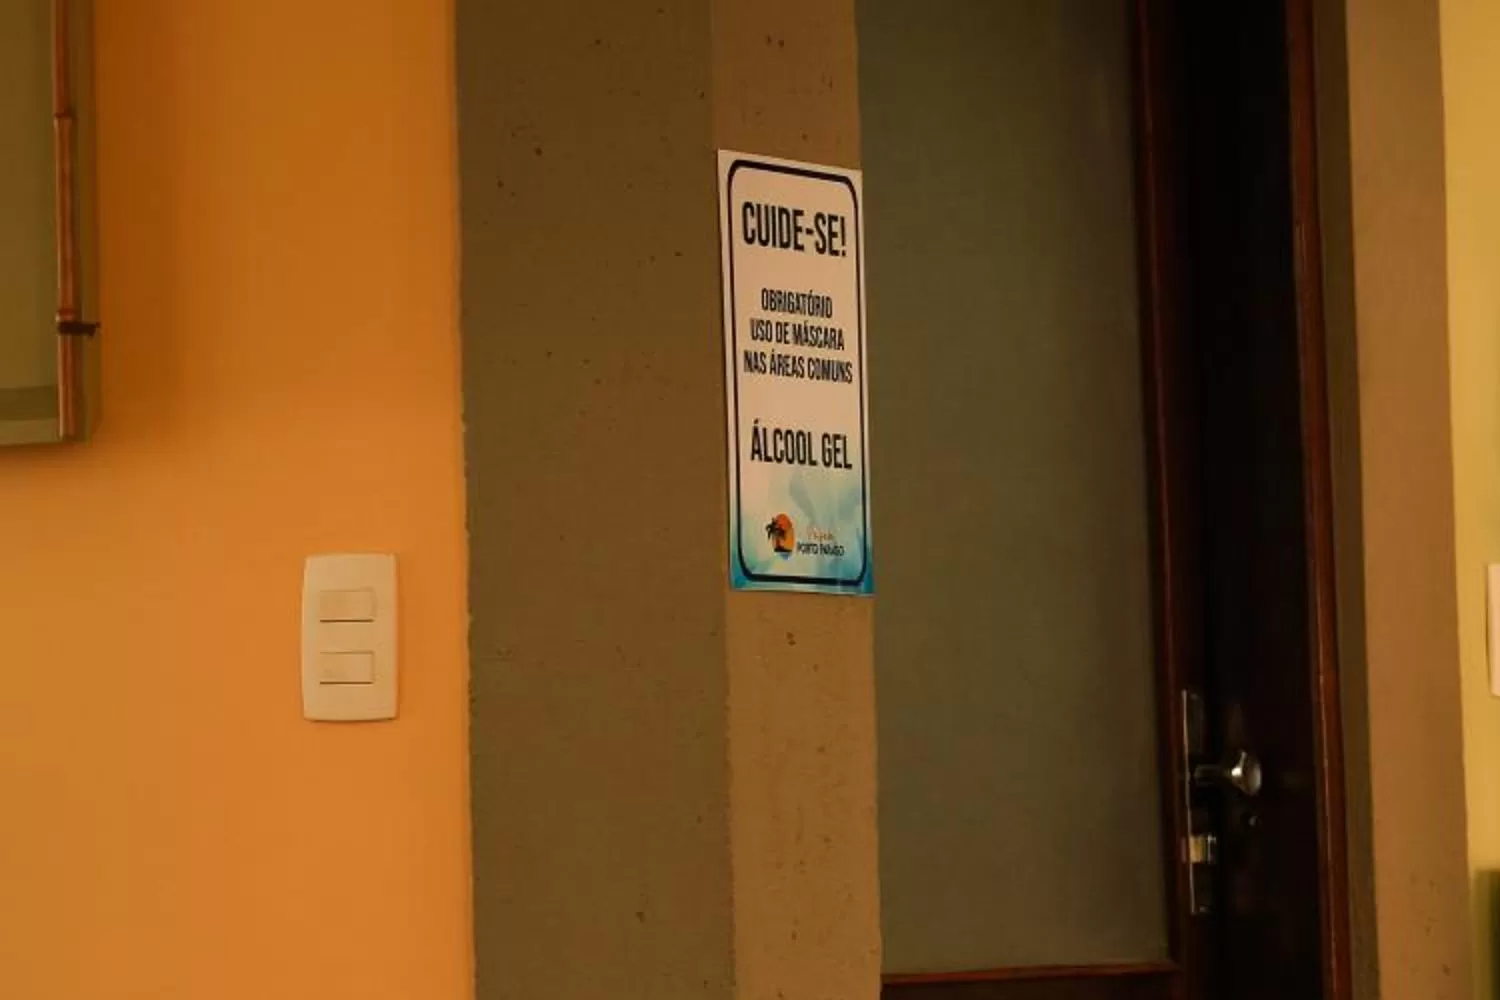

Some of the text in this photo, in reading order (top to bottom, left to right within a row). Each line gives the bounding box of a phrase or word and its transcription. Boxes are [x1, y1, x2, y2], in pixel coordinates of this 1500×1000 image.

[742, 201, 847, 257] CUIDE-SE!
[761, 288, 833, 318] OBRIGATÓRIO
[750, 318, 845, 351] USO DE MÁSCARA
[744, 349, 853, 384] NAS ÁREAS COMUNS
[751, 418, 853, 470] ÁLCOOL GEL
